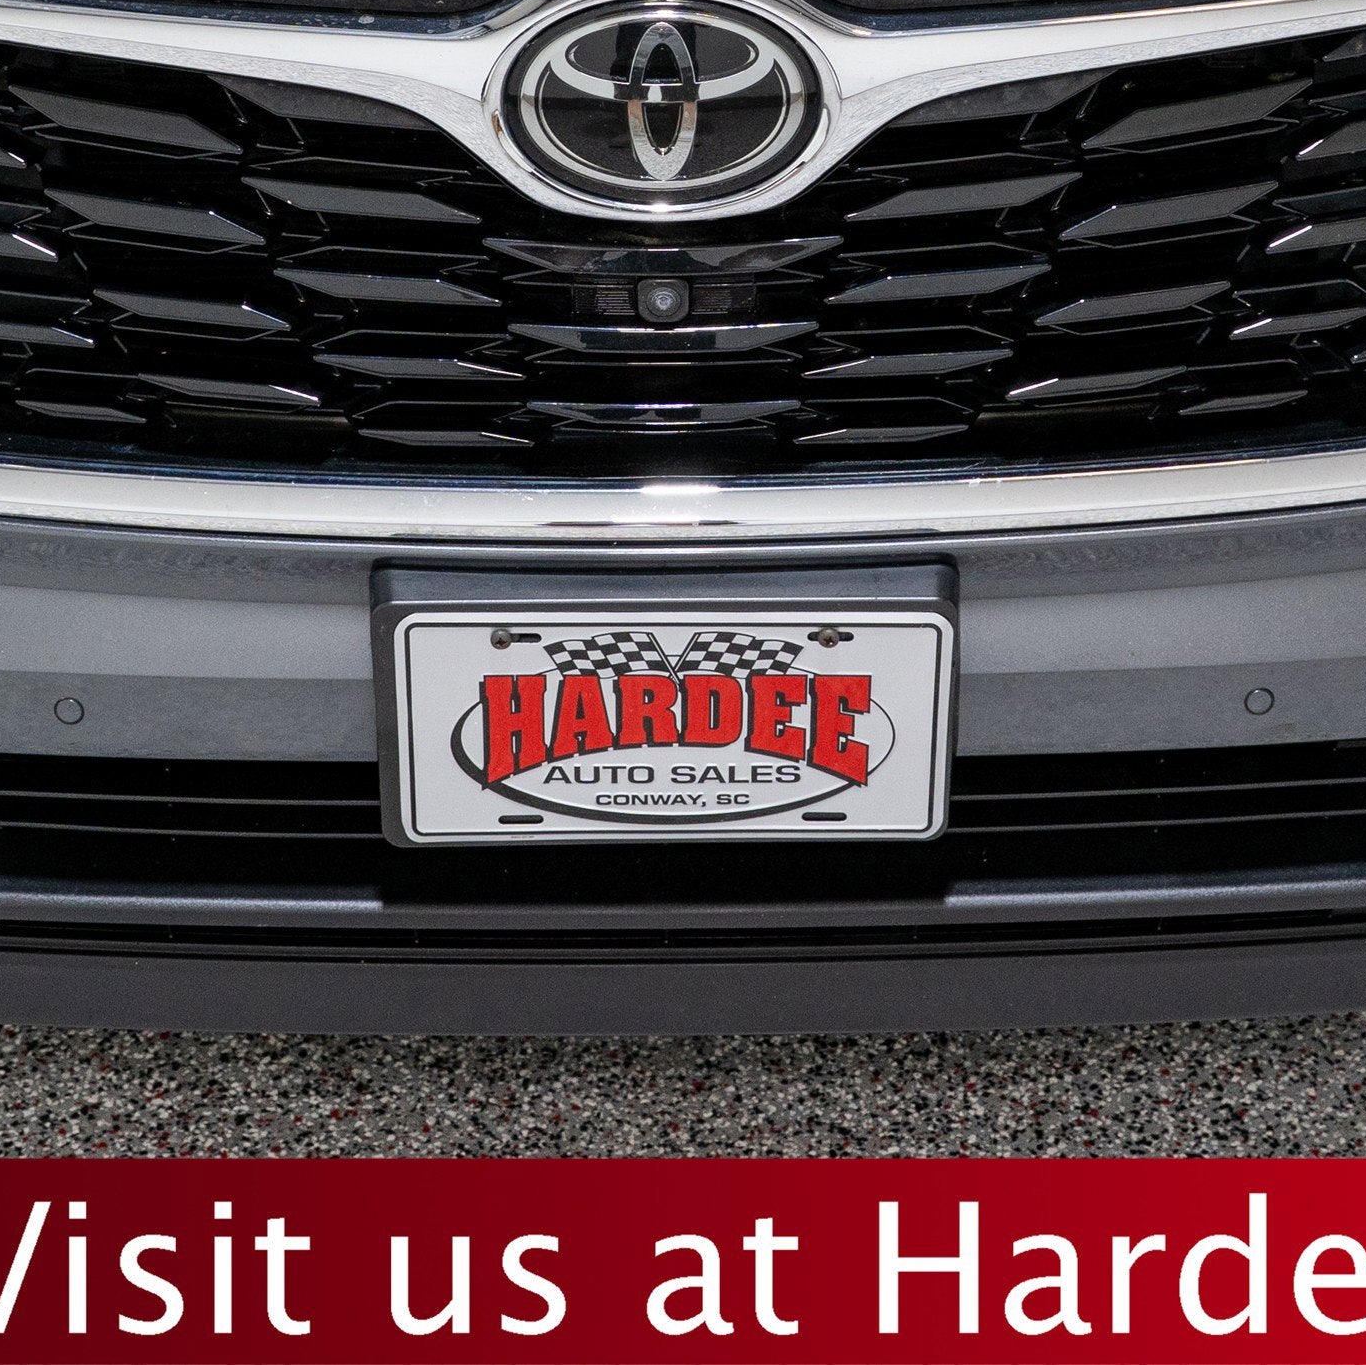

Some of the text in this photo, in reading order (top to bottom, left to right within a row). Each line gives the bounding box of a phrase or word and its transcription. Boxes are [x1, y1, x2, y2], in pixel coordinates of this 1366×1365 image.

[480, 673, 872, 789] HARDEE
[542, 765, 802, 784] AUTO SALES
[595, 793, 751, 808] CONWAY, SC
